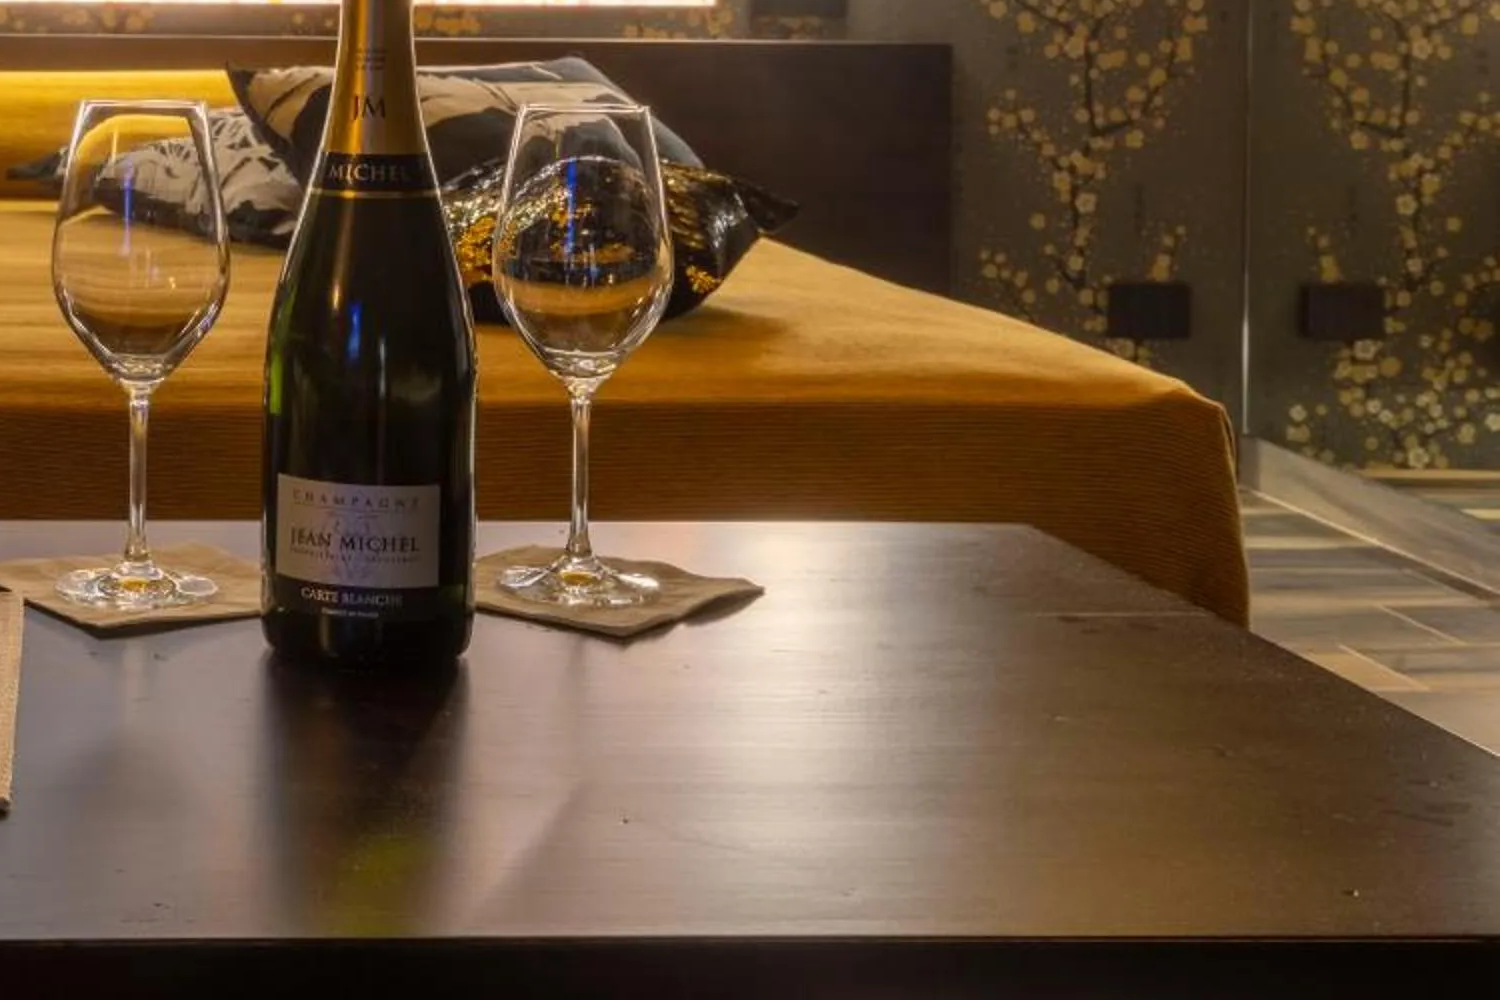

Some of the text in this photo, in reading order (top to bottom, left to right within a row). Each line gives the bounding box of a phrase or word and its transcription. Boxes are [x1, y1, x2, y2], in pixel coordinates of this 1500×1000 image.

[353, 95, 386, 120] JM
[293, 489, 420, 508] CHAMPAGNE
[291, 527, 419, 553] JEAN MICHEL
[301, 587, 403, 607] CARTE BLANCHE
